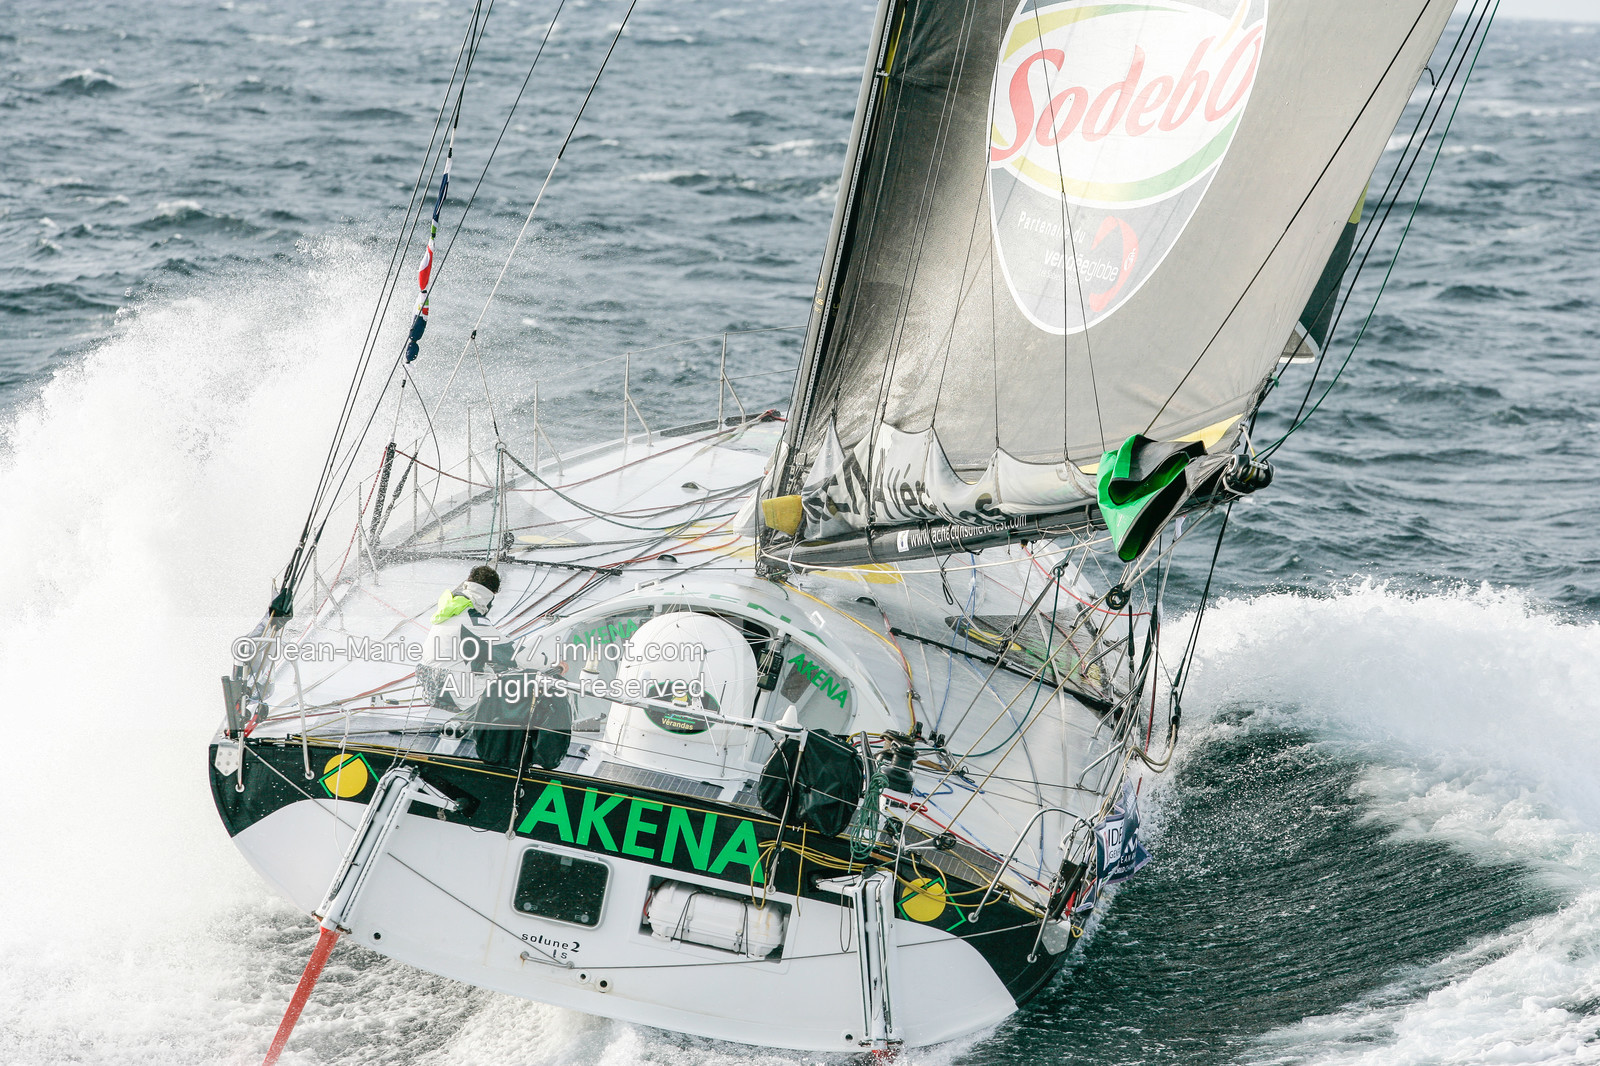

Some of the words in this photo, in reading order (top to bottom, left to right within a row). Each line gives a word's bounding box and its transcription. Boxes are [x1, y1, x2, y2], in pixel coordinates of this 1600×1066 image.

[1017, 211, 1070, 240] Partenaie
[1072, 226, 1086, 244] du
[573, 618, 639, 649] AKENA
[787, 653, 848, 709] AKENA
[661, 717, 694, 731] Vérandas
[516, 778, 765, 884] AKENA
